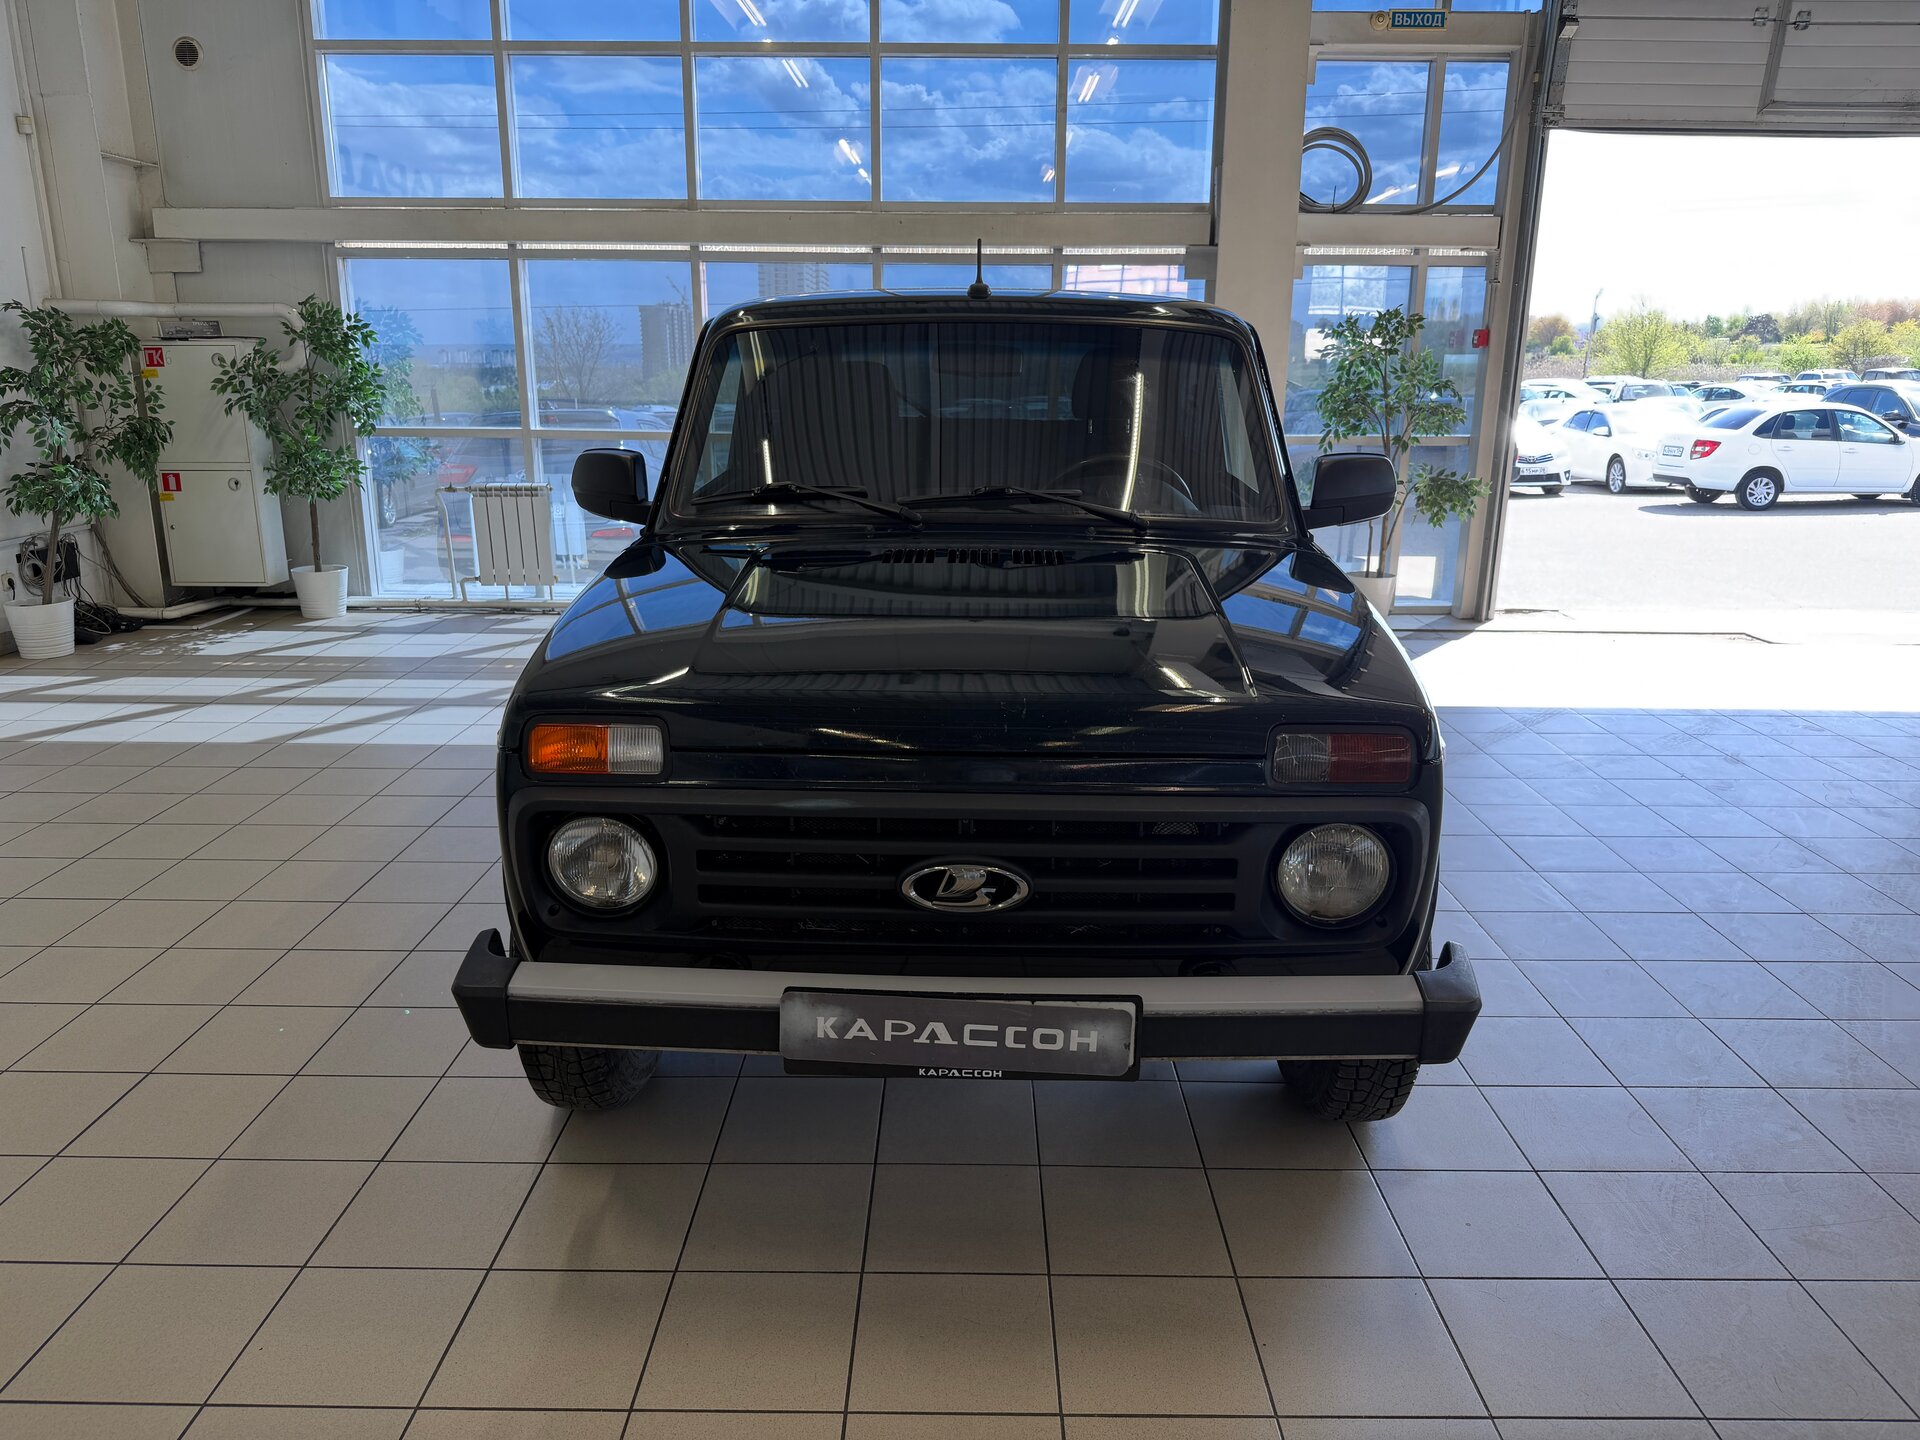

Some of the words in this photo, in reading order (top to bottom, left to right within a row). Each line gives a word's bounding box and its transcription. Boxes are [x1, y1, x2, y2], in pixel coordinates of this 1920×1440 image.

[1395, 13, 1442, 27] ВЫХОД
[145, 349, 164, 365] ПК
[815, 1016, 1099, 1053] КАРАССОН
[918, 1068, 1002, 1078] КАРАССОН
